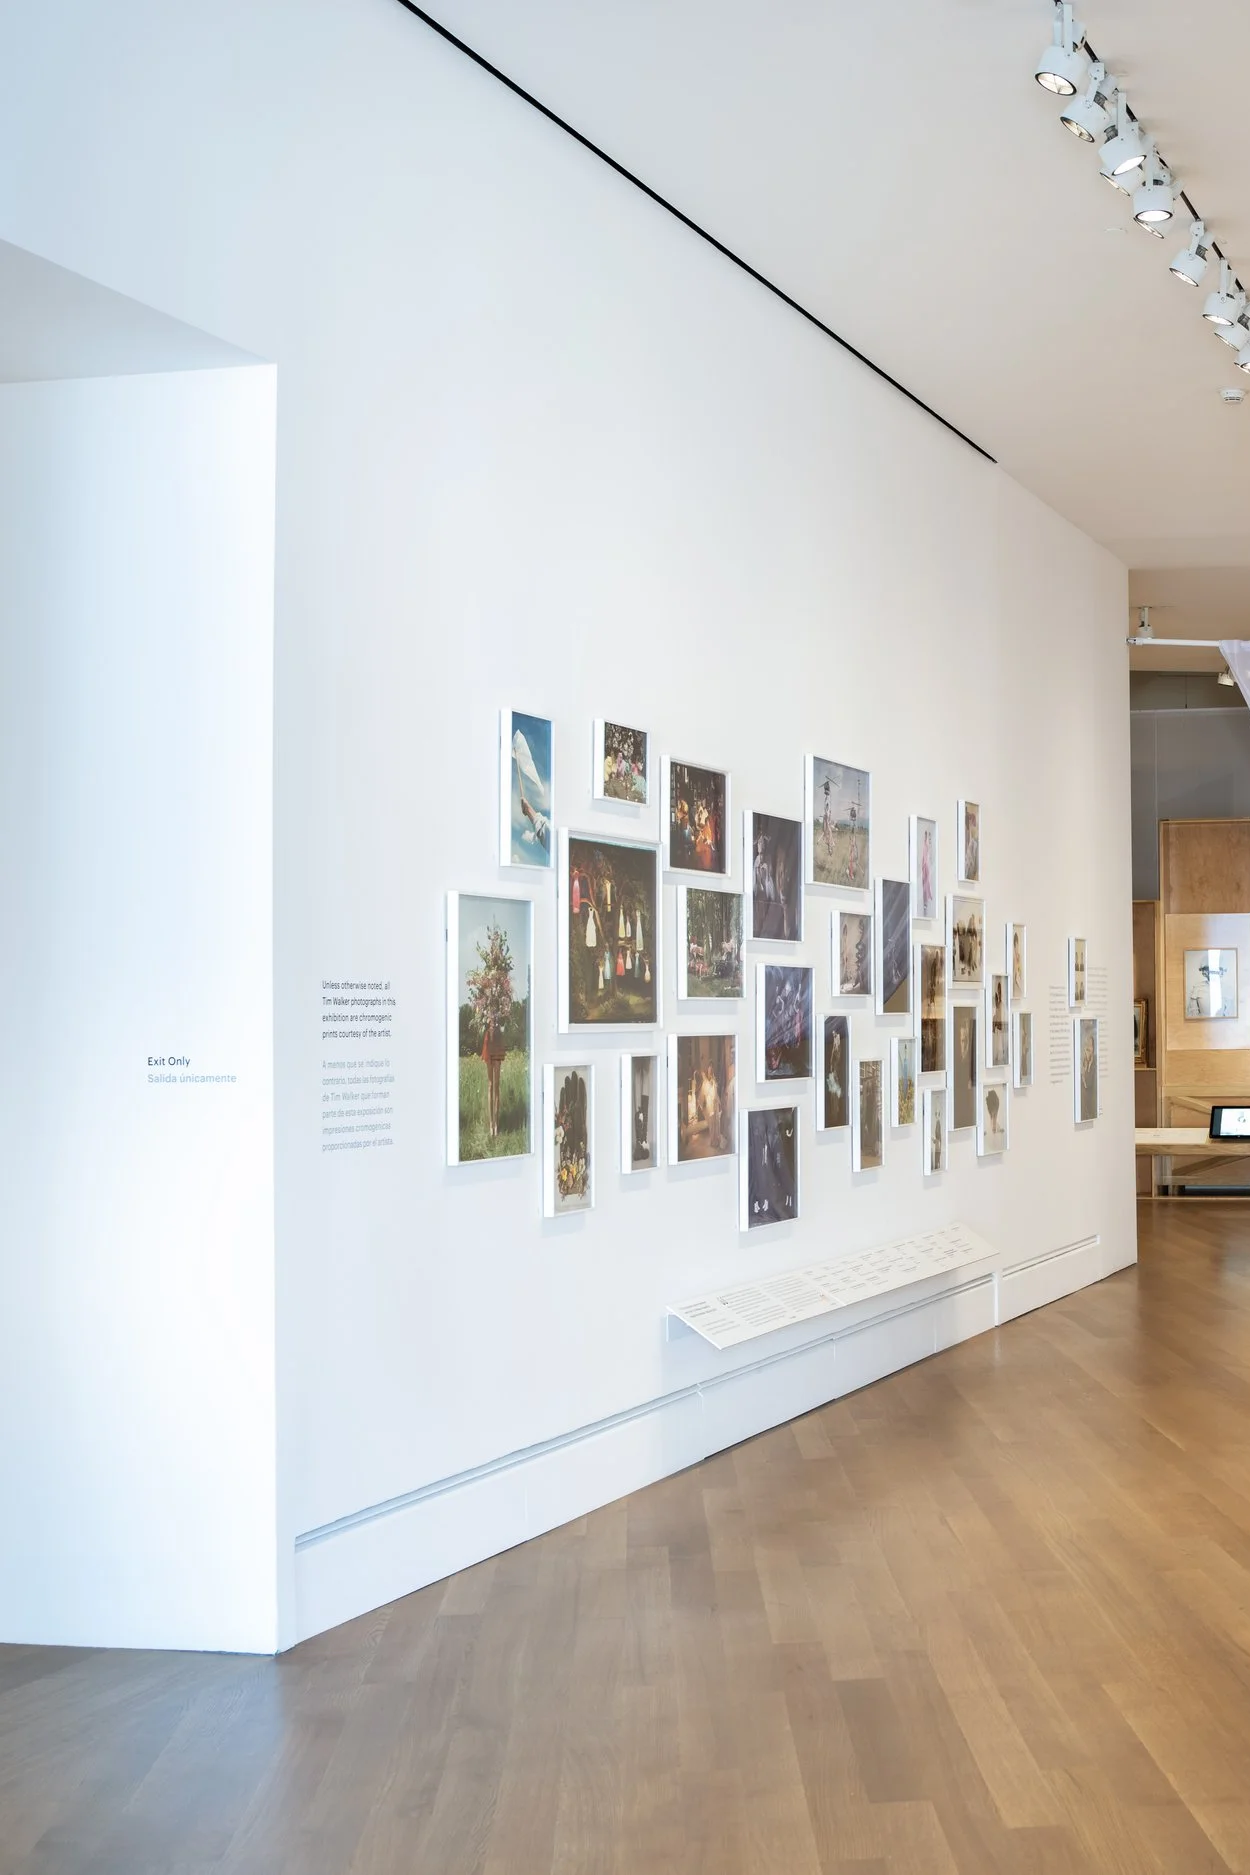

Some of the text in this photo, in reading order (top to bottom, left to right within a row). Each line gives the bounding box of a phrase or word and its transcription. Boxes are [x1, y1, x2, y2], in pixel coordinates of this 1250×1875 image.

[322, 980, 340, 990] Unless
[341, 980, 366, 990] otherwise
[322, 997, 396, 1007] Tim Walker photographs in this
[322, 1013, 348, 1022] exhibition
[359, 1013, 392, 1023] chromogenic
[322, 1029, 337, 1040] prints
[339, 1030, 361, 1039] courtesy
[362, 1028, 368, 1037] of
[368, 1029, 376, 1037] the
[148, 1056, 190, 1068] Exit Only
[148, 1073, 237, 1083] Salida únicamente
[330, 1092, 340, 1101] Tim
[342, 1092, 359, 1100] Walker
